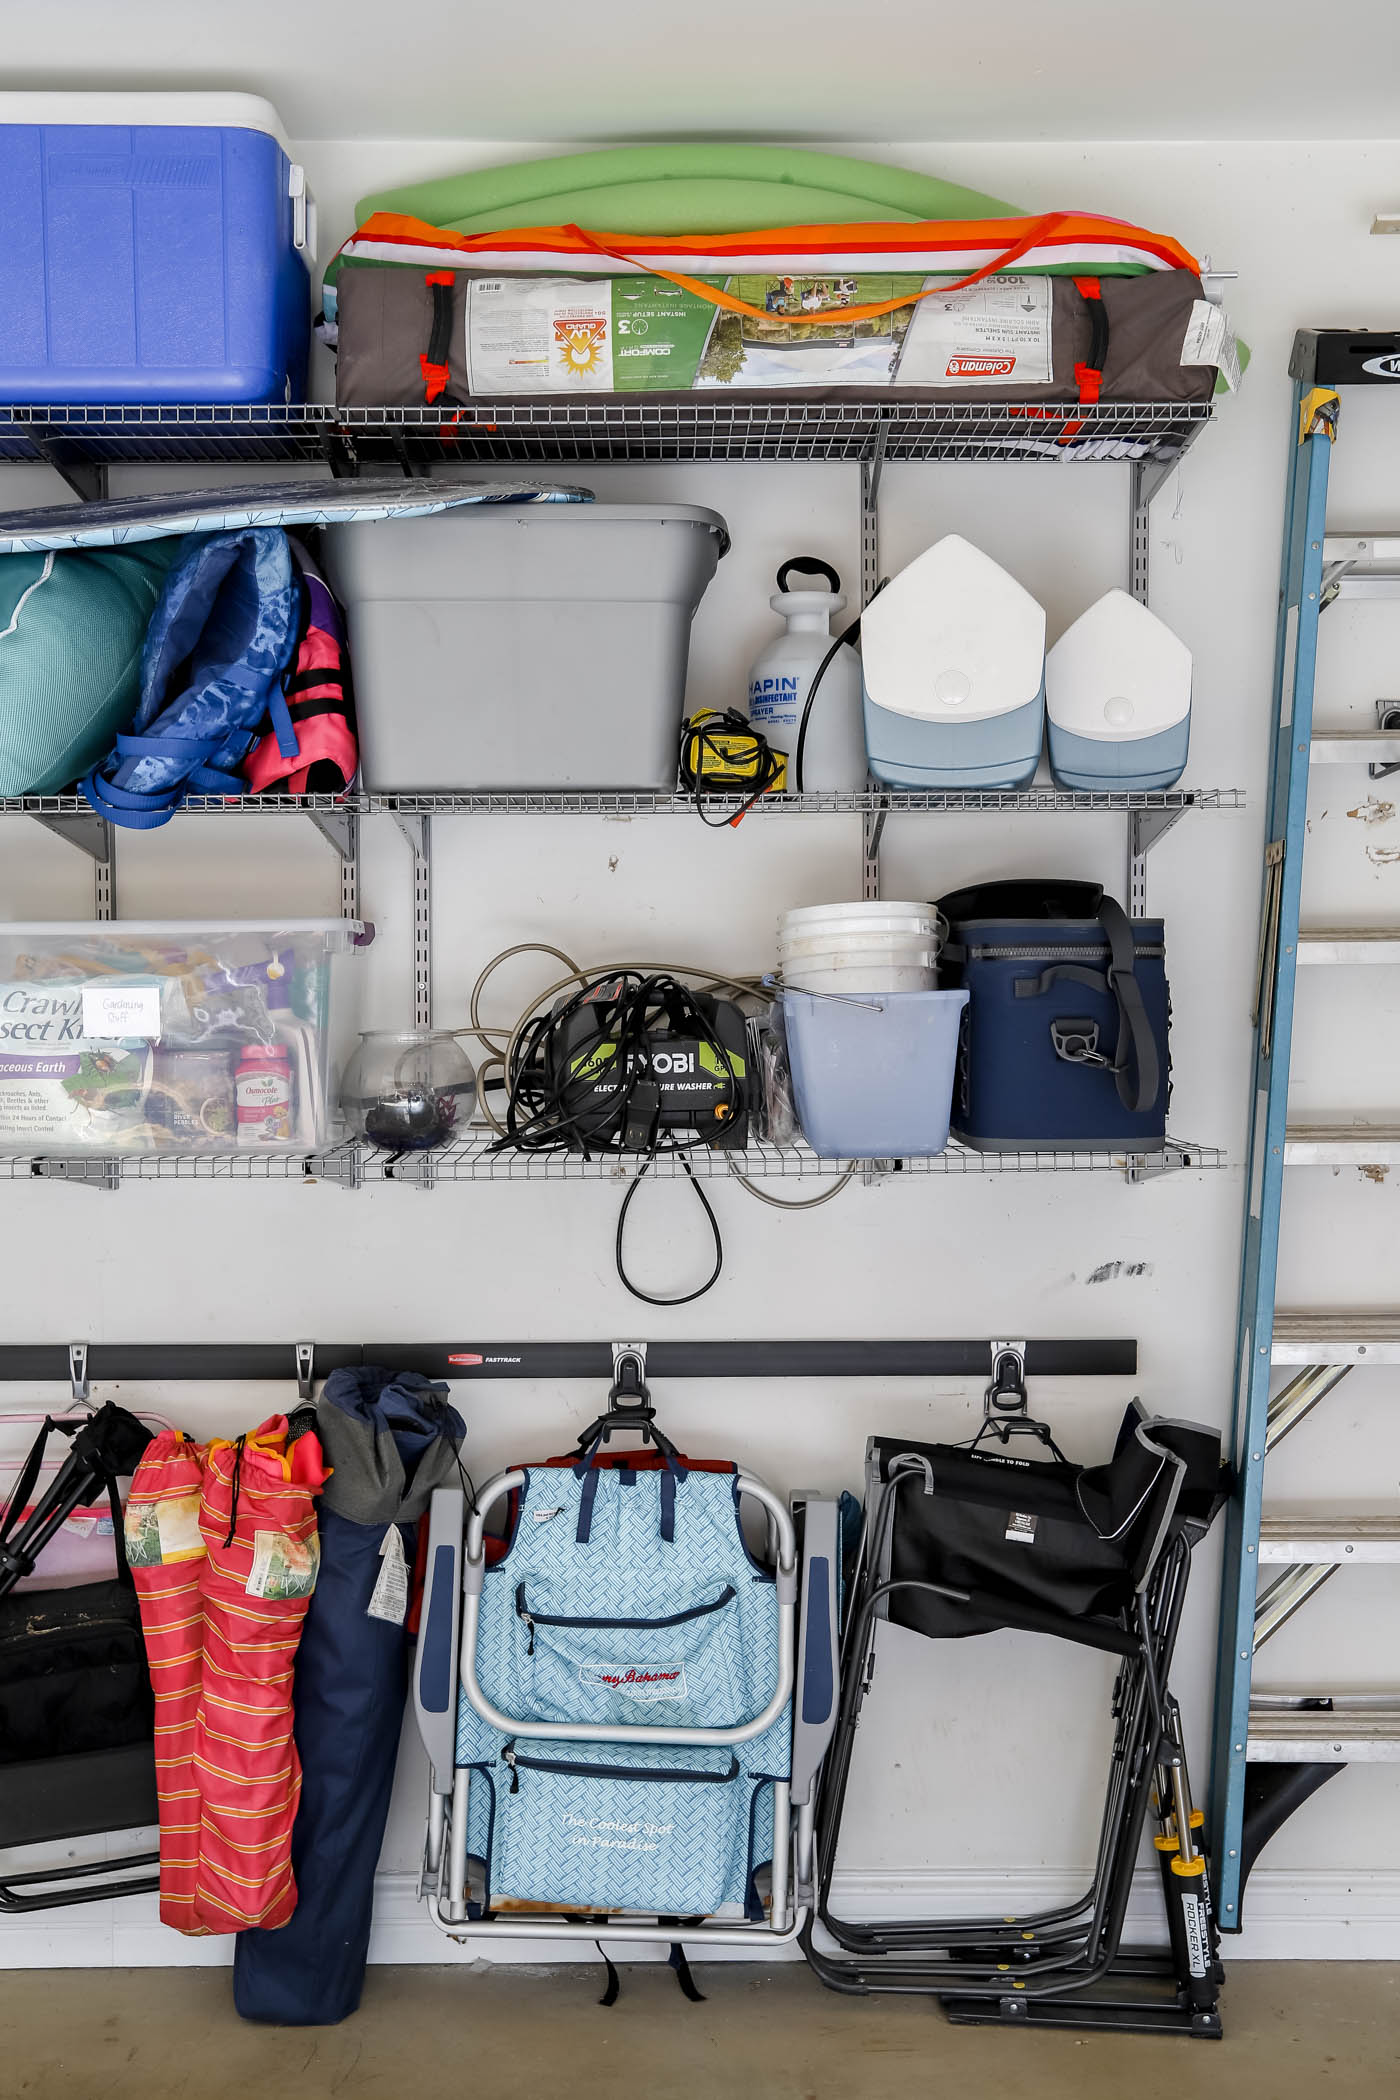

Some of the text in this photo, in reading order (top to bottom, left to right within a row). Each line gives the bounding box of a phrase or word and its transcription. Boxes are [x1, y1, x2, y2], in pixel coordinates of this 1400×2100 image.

[618, 320, 631, 334] 3
[571, 329, 590, 340] UV
[618, 347, 671, 357] COMFORT
[961, 361, 1011, 375] Coleman
[749, 677, 797, 695] HAPIN
[3, 990, 83, 1016] Crawl
[36, 1062, 66, 1073] Earth
[245, 1086, 278, 1095] Osmocote
[593, 1084, 629, 1093] ELECTI
[677, 1083, 713, 1091] WASHER
[561, 1812, 675, 1838] The Coolest Spot
[571, 1835, 657, 1851] in Paradise
[1186, 1902, 1201, 1969] ROCKER XL
[1198, 1902, 1211, 1968] FREESTYLE
